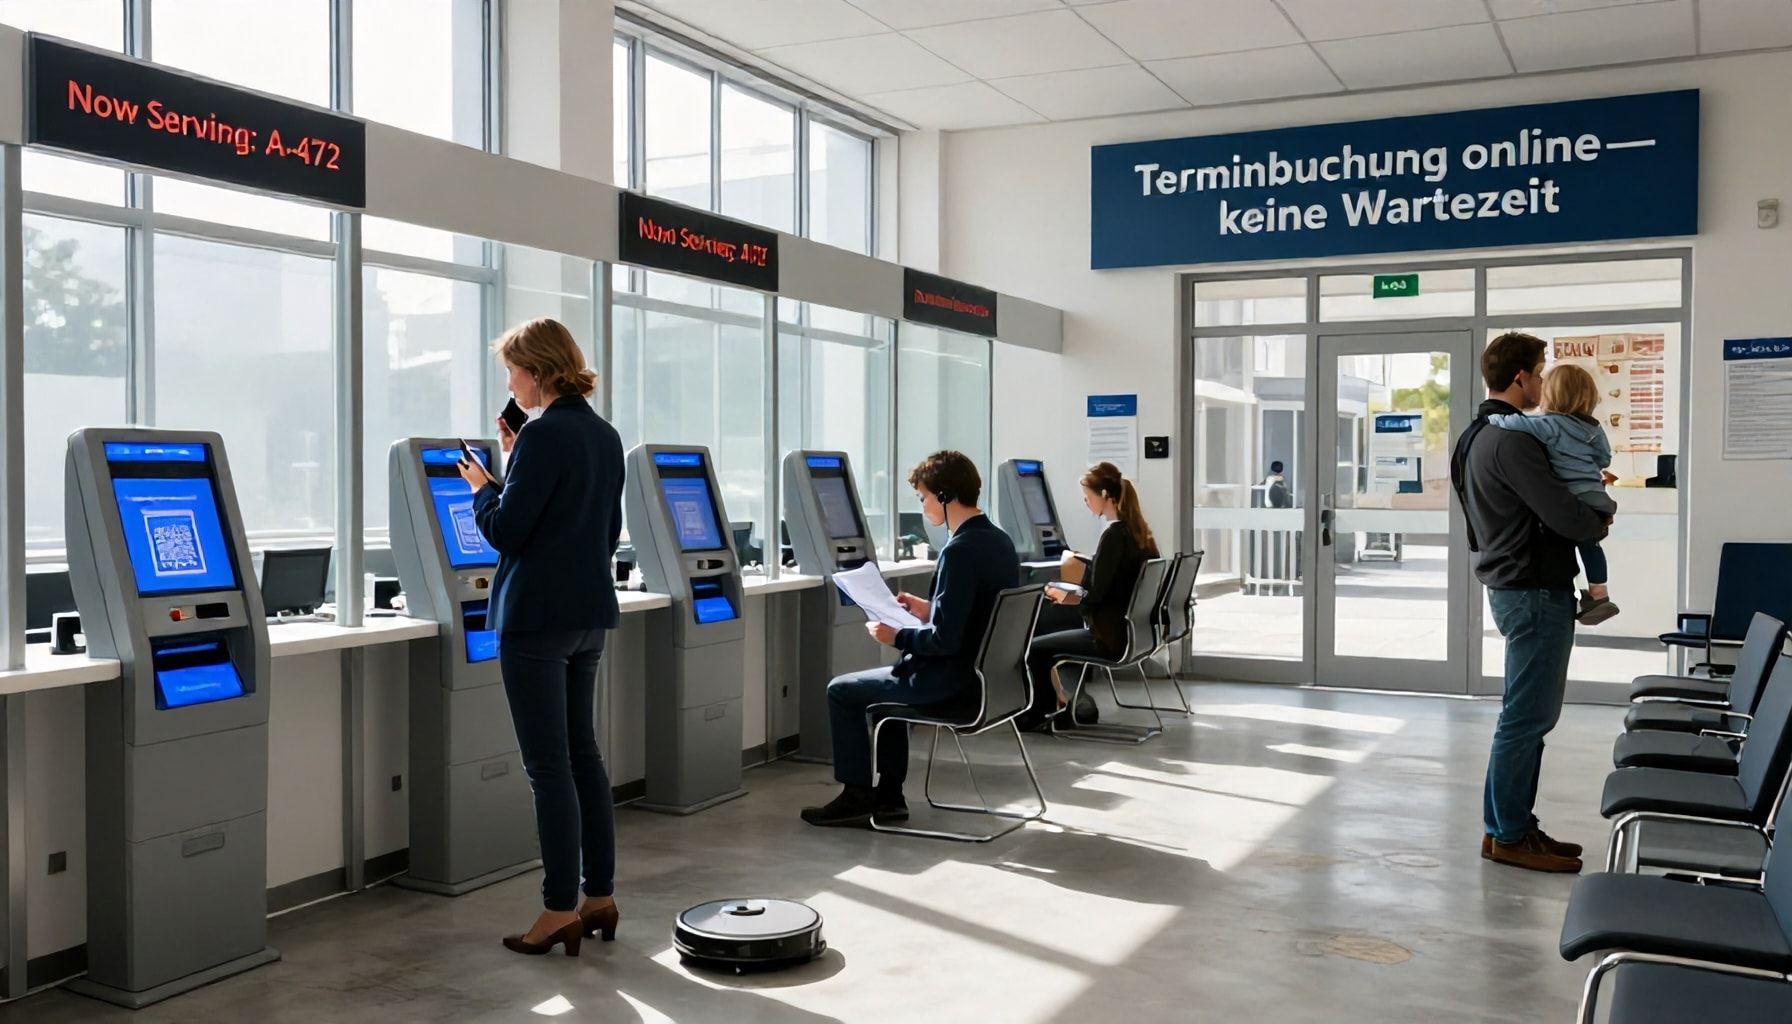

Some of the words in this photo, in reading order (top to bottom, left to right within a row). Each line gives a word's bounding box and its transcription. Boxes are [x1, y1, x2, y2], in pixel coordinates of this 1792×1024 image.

[67, 79, 139, 125] Now
[146, 100, 257, 156] Serving:
[1134, 144, 1448, 197] Terminbuchung
[1219, 197, 1328, 236] keine
[1341, 176, 1560, 227] Wartezeit
